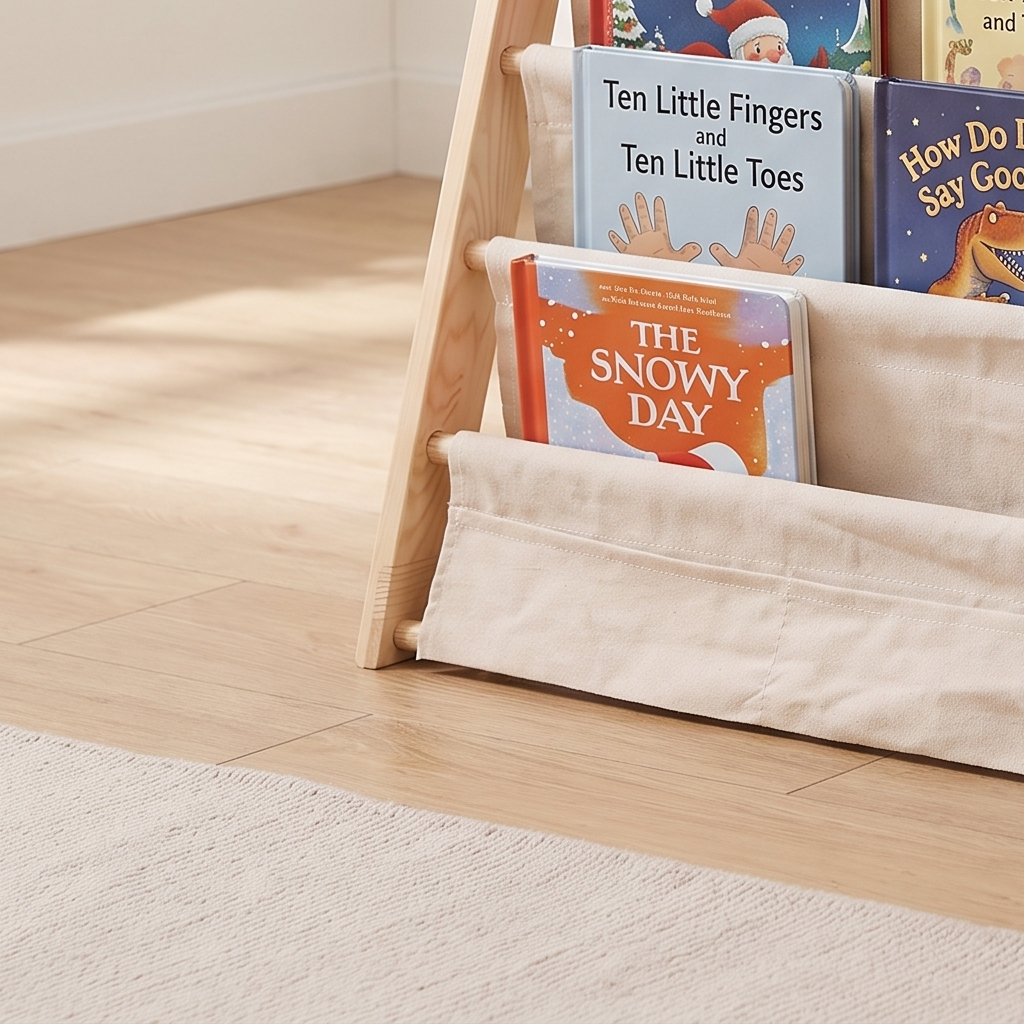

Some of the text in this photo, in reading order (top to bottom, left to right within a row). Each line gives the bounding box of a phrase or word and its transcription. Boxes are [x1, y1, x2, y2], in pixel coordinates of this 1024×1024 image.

[983, 13, 1015, 32] and
[603, 79, 823, 134] Ten Little Fingers
[696, 128, 726, 147] and
[899, 134, 960, 182] How
[966, 120, 1008, 154] Do
[621, 143, 804, 192] Ten Little Toes
[918, 176, 964, 218] Say
[630, 320, 701, 354] THE
[591, 349, 749, 402] SNOWY
[628, 392, 712, 436] DAY
